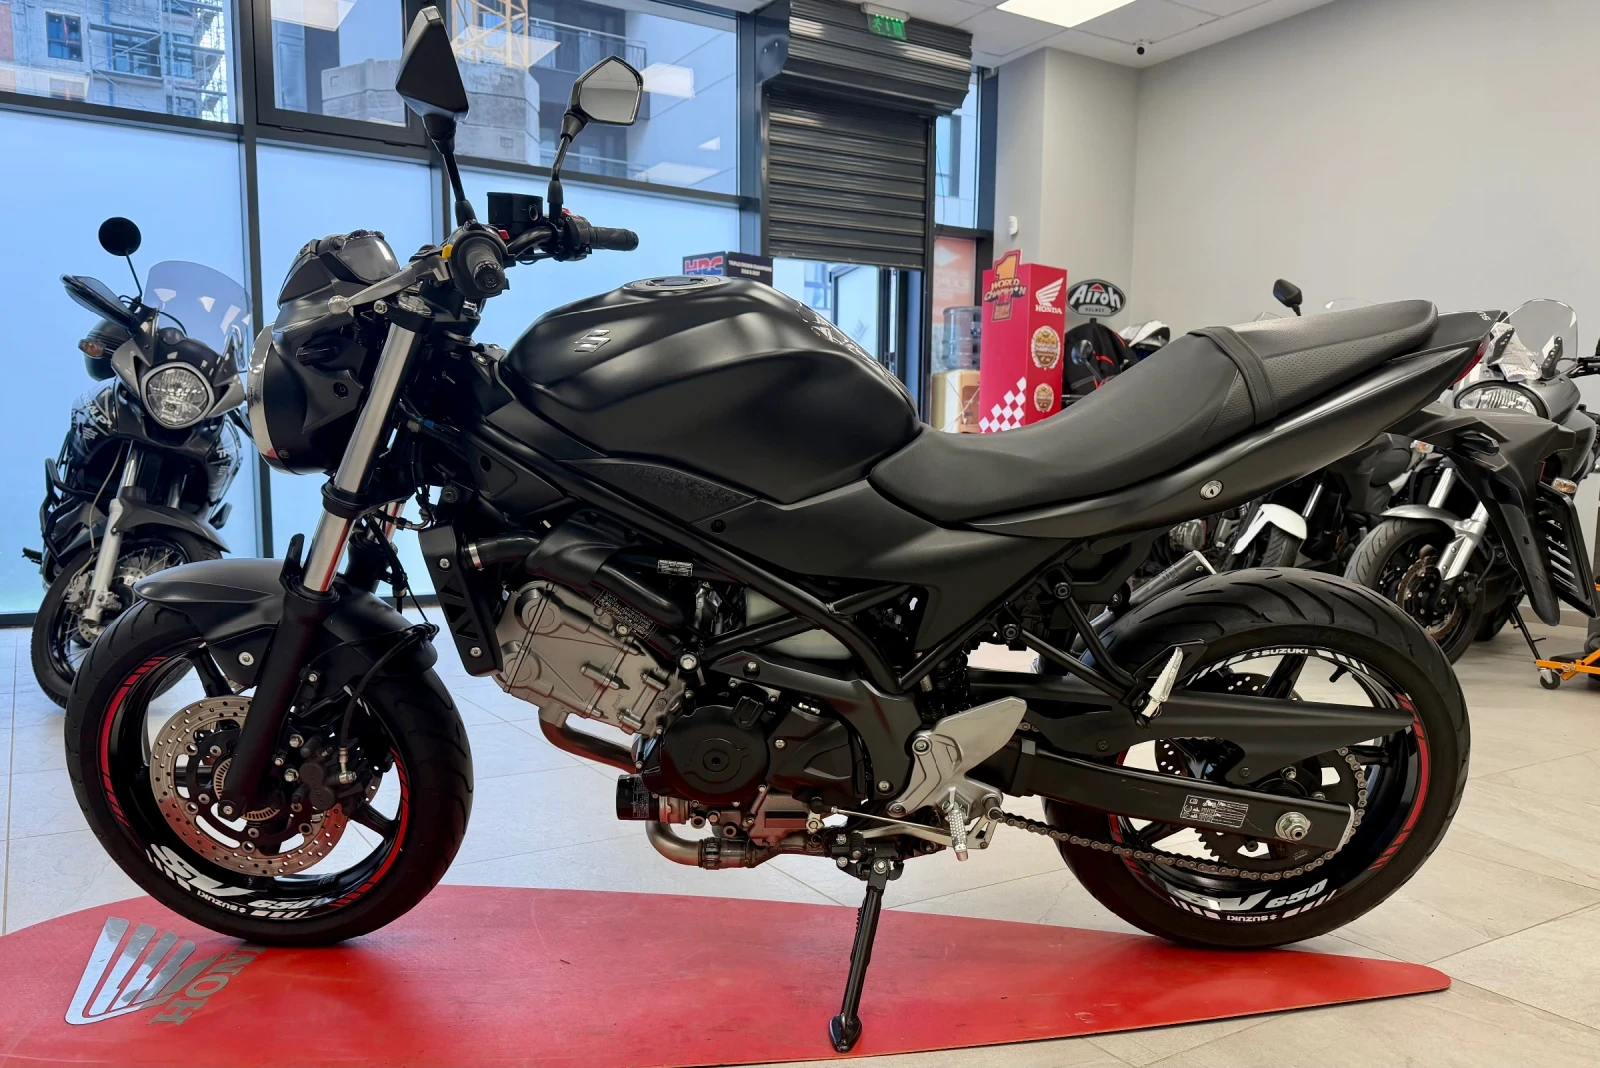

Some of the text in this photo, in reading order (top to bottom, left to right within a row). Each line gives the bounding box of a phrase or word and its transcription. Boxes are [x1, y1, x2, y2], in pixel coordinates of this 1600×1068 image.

[685, 256, 724, 276] HRC
[991, 278, 1020, 292] WORLD
[1069, 284, 1121, 309] Airoh
[1035, 304, 1063, 315] HONDA
[1261, 648, 1309, 656] SUZUKI
[196, 889, 238, 911] SUZUKI
[1264, 878, 1329, 909] 650
[248, 899, 316, 910] 650
[1226, 914, 1271, 922] SUZUKI
[146, 943, 266, 1026] HON
